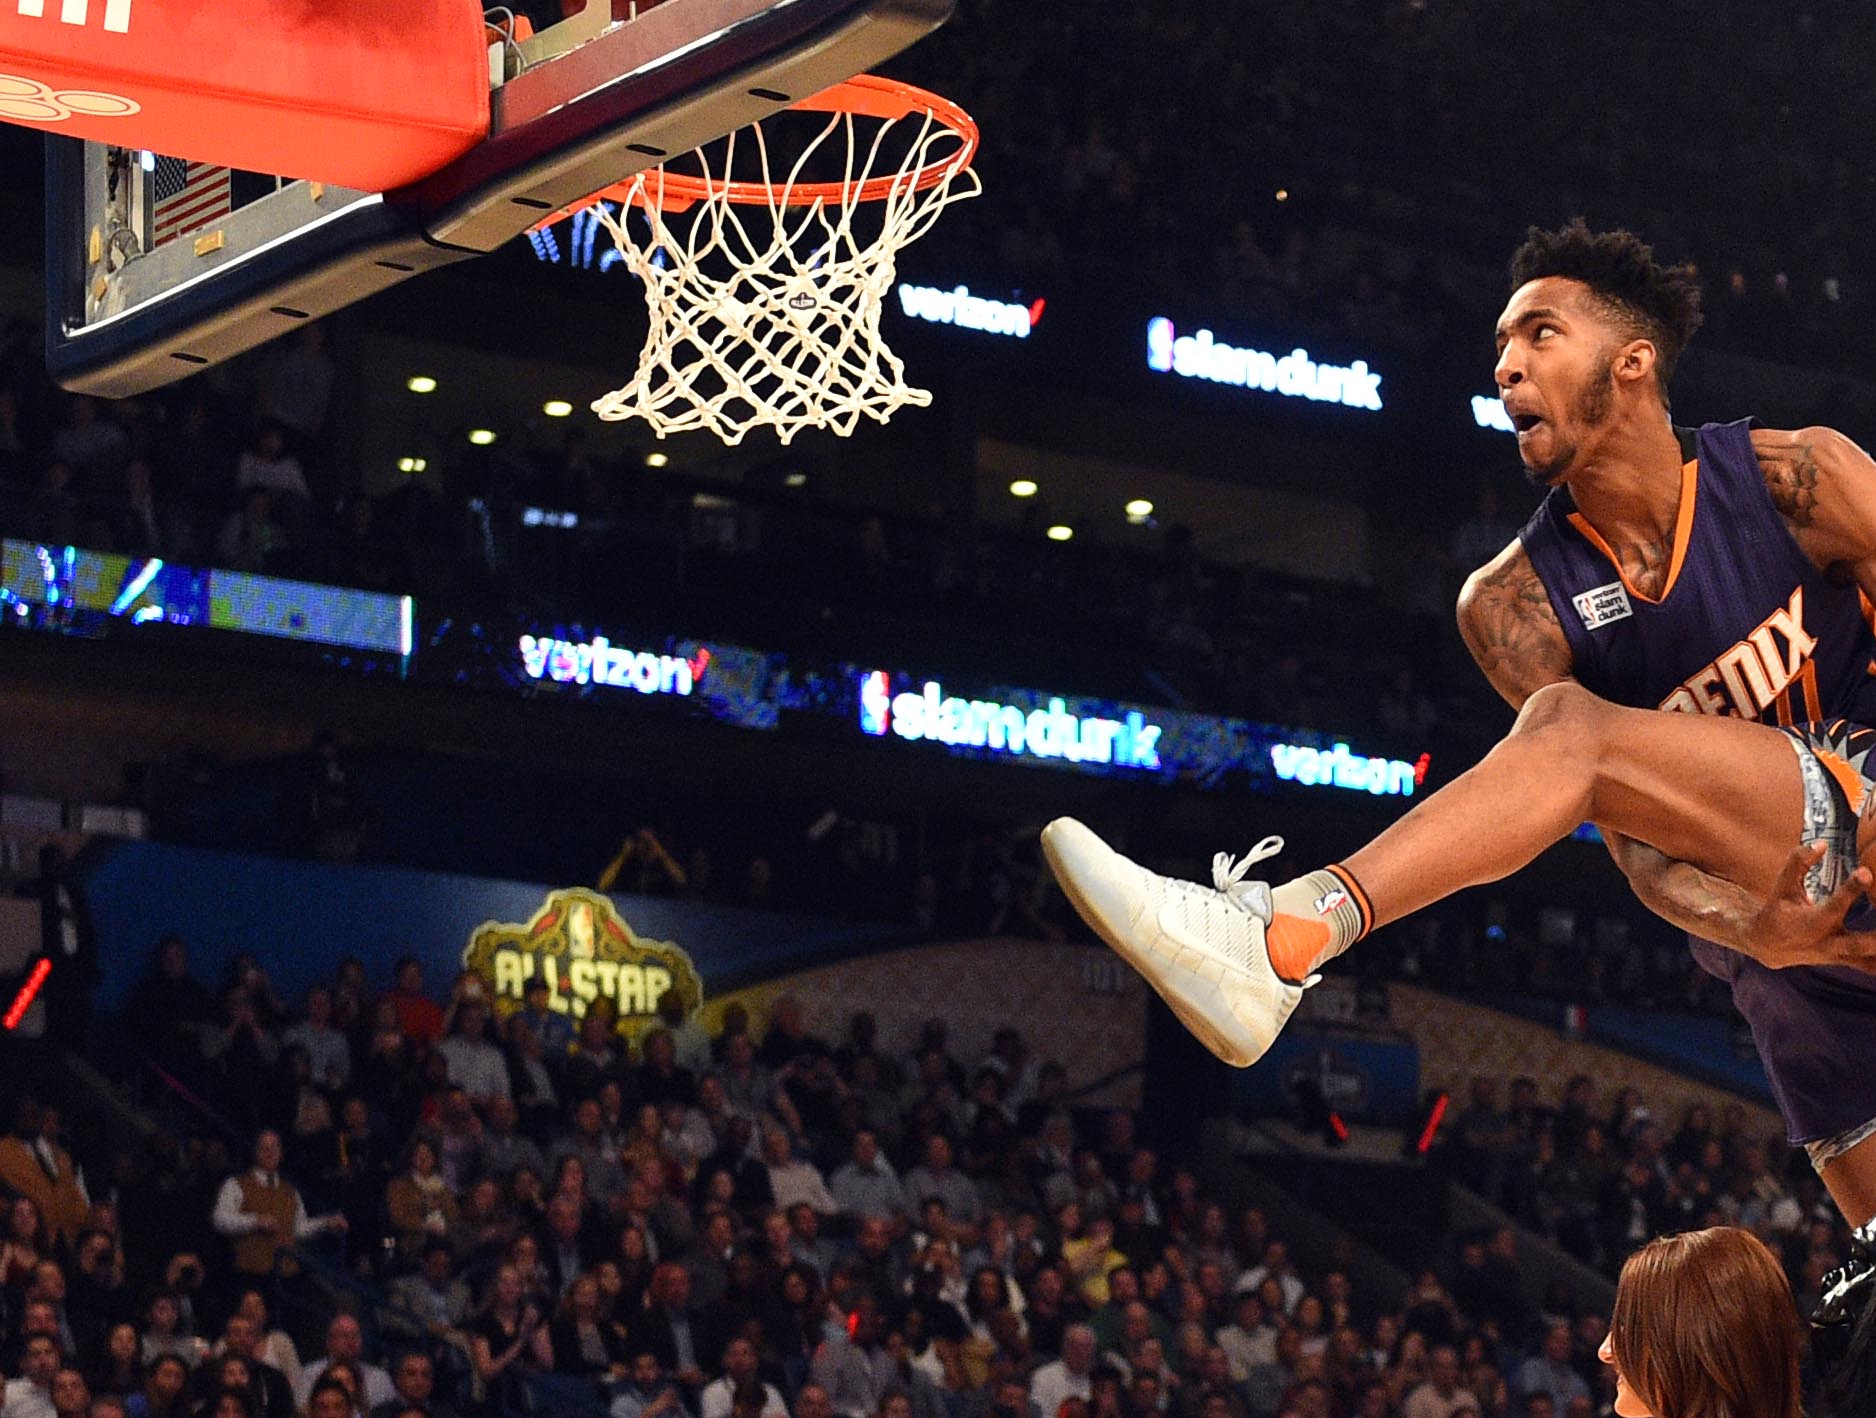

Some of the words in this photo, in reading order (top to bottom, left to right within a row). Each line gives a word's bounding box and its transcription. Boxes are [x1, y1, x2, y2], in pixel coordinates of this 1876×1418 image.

[899, 283, 1031, 338] verizon
[1594, 596, 1623, 611] slam
[1598, 605, 1628, 621] dunk
[520, 635, 692, 695] verizon
[1271, 743, 1415, 796] verizon
